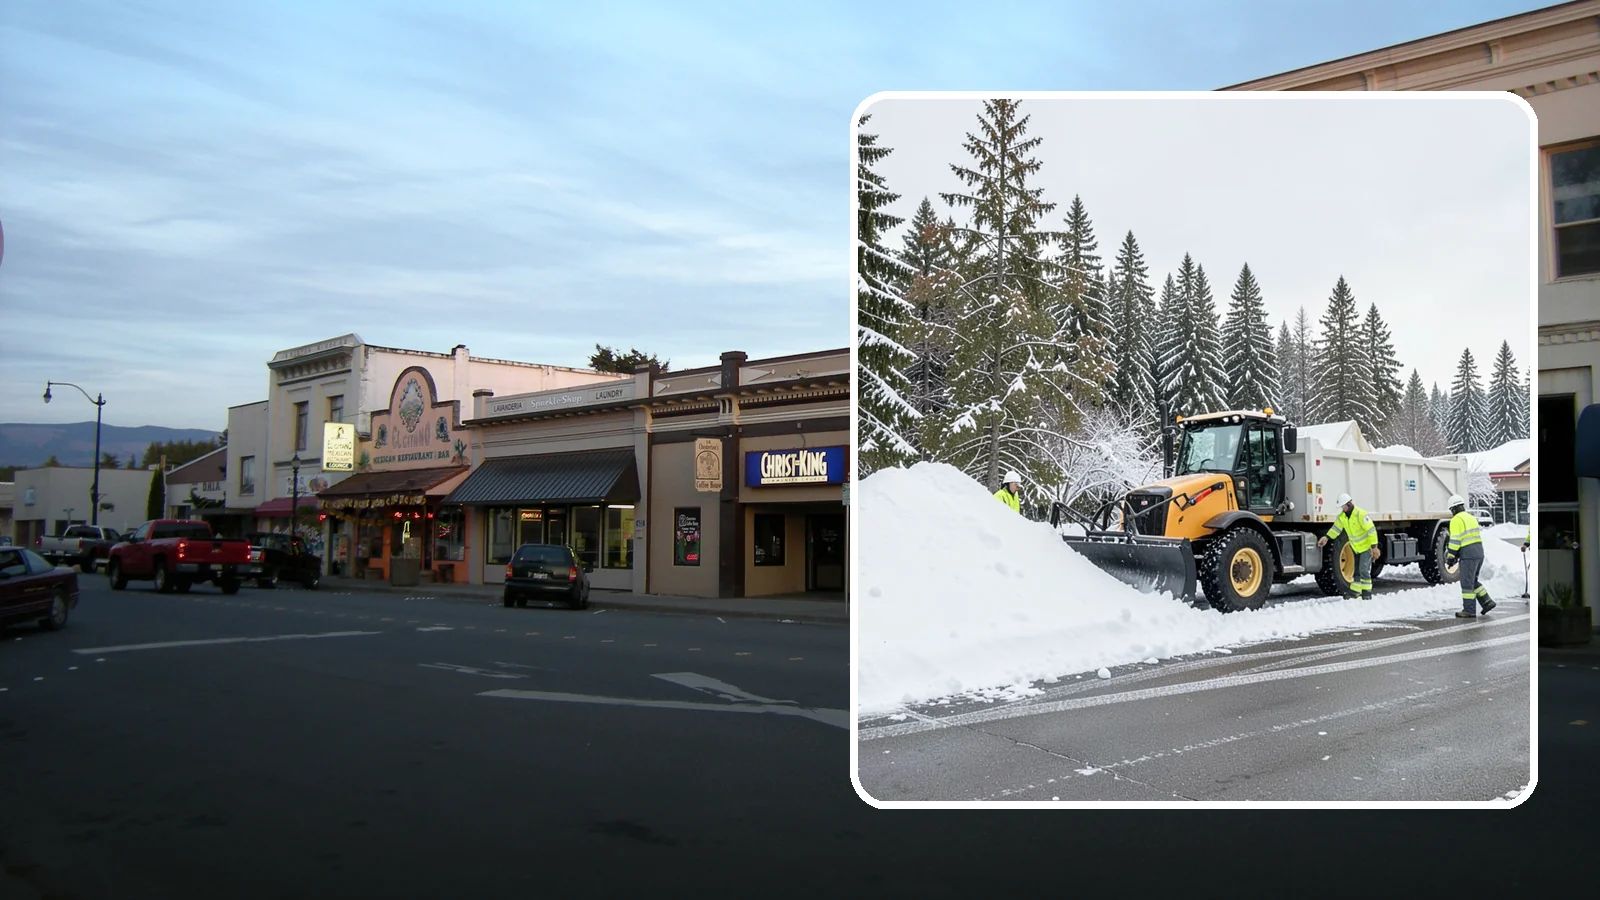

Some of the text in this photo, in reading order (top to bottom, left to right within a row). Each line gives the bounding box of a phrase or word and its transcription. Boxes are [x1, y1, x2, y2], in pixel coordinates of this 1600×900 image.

[493, 388, 624, 412] LAVANDERIA Sparkle Shop LAUNDRY
[373, 455, 396, 465] MEXICAN
[397, 451, 433, 462] RESTAURANT
[438, 449, 450, 459] BAR
[761, 450, 827, 478] CHRIST KING
[696, 480, 722, 489] Coffee House
